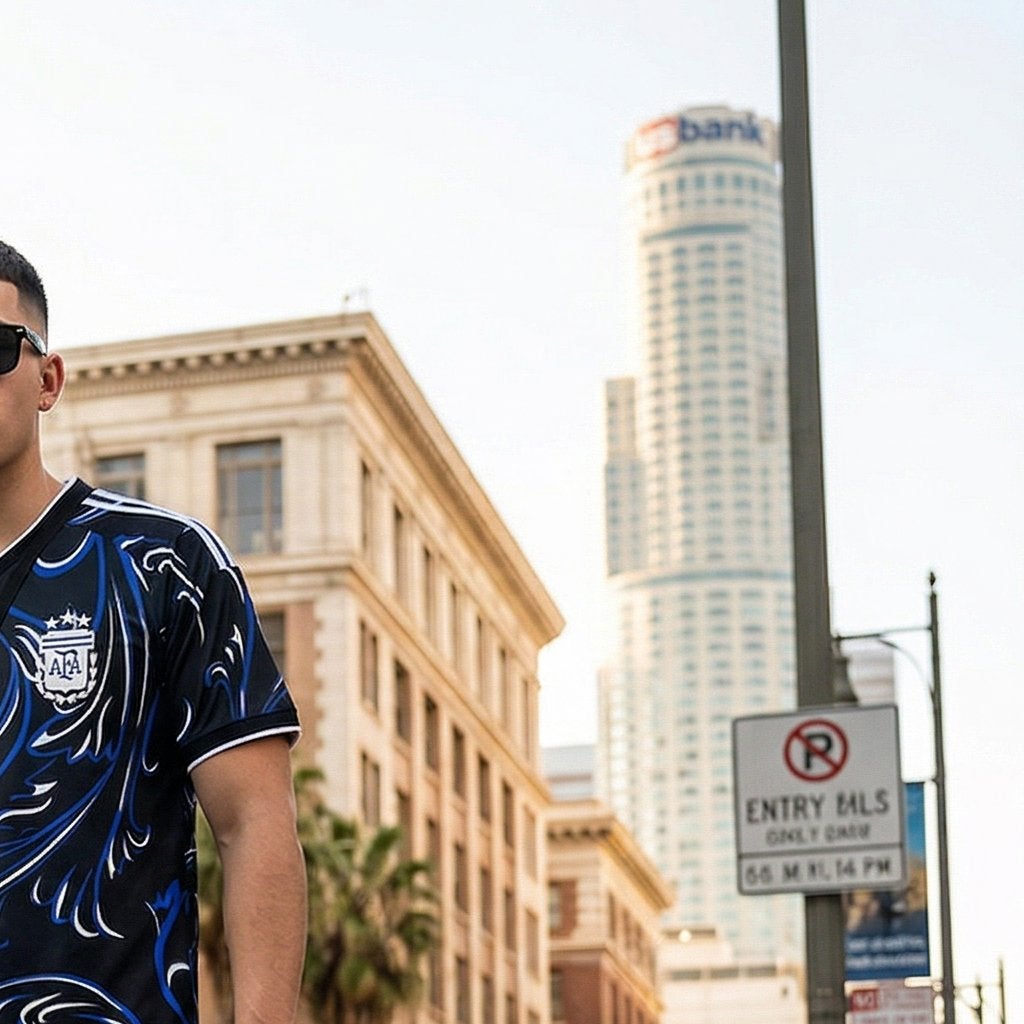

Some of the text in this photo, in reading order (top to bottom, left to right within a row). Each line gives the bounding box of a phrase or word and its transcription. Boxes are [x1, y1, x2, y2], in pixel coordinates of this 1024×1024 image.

[679, 112, 763, 147] bank
[48, 649, 82, 681] AFA
[746, 793, 824, 823] ENTRY
